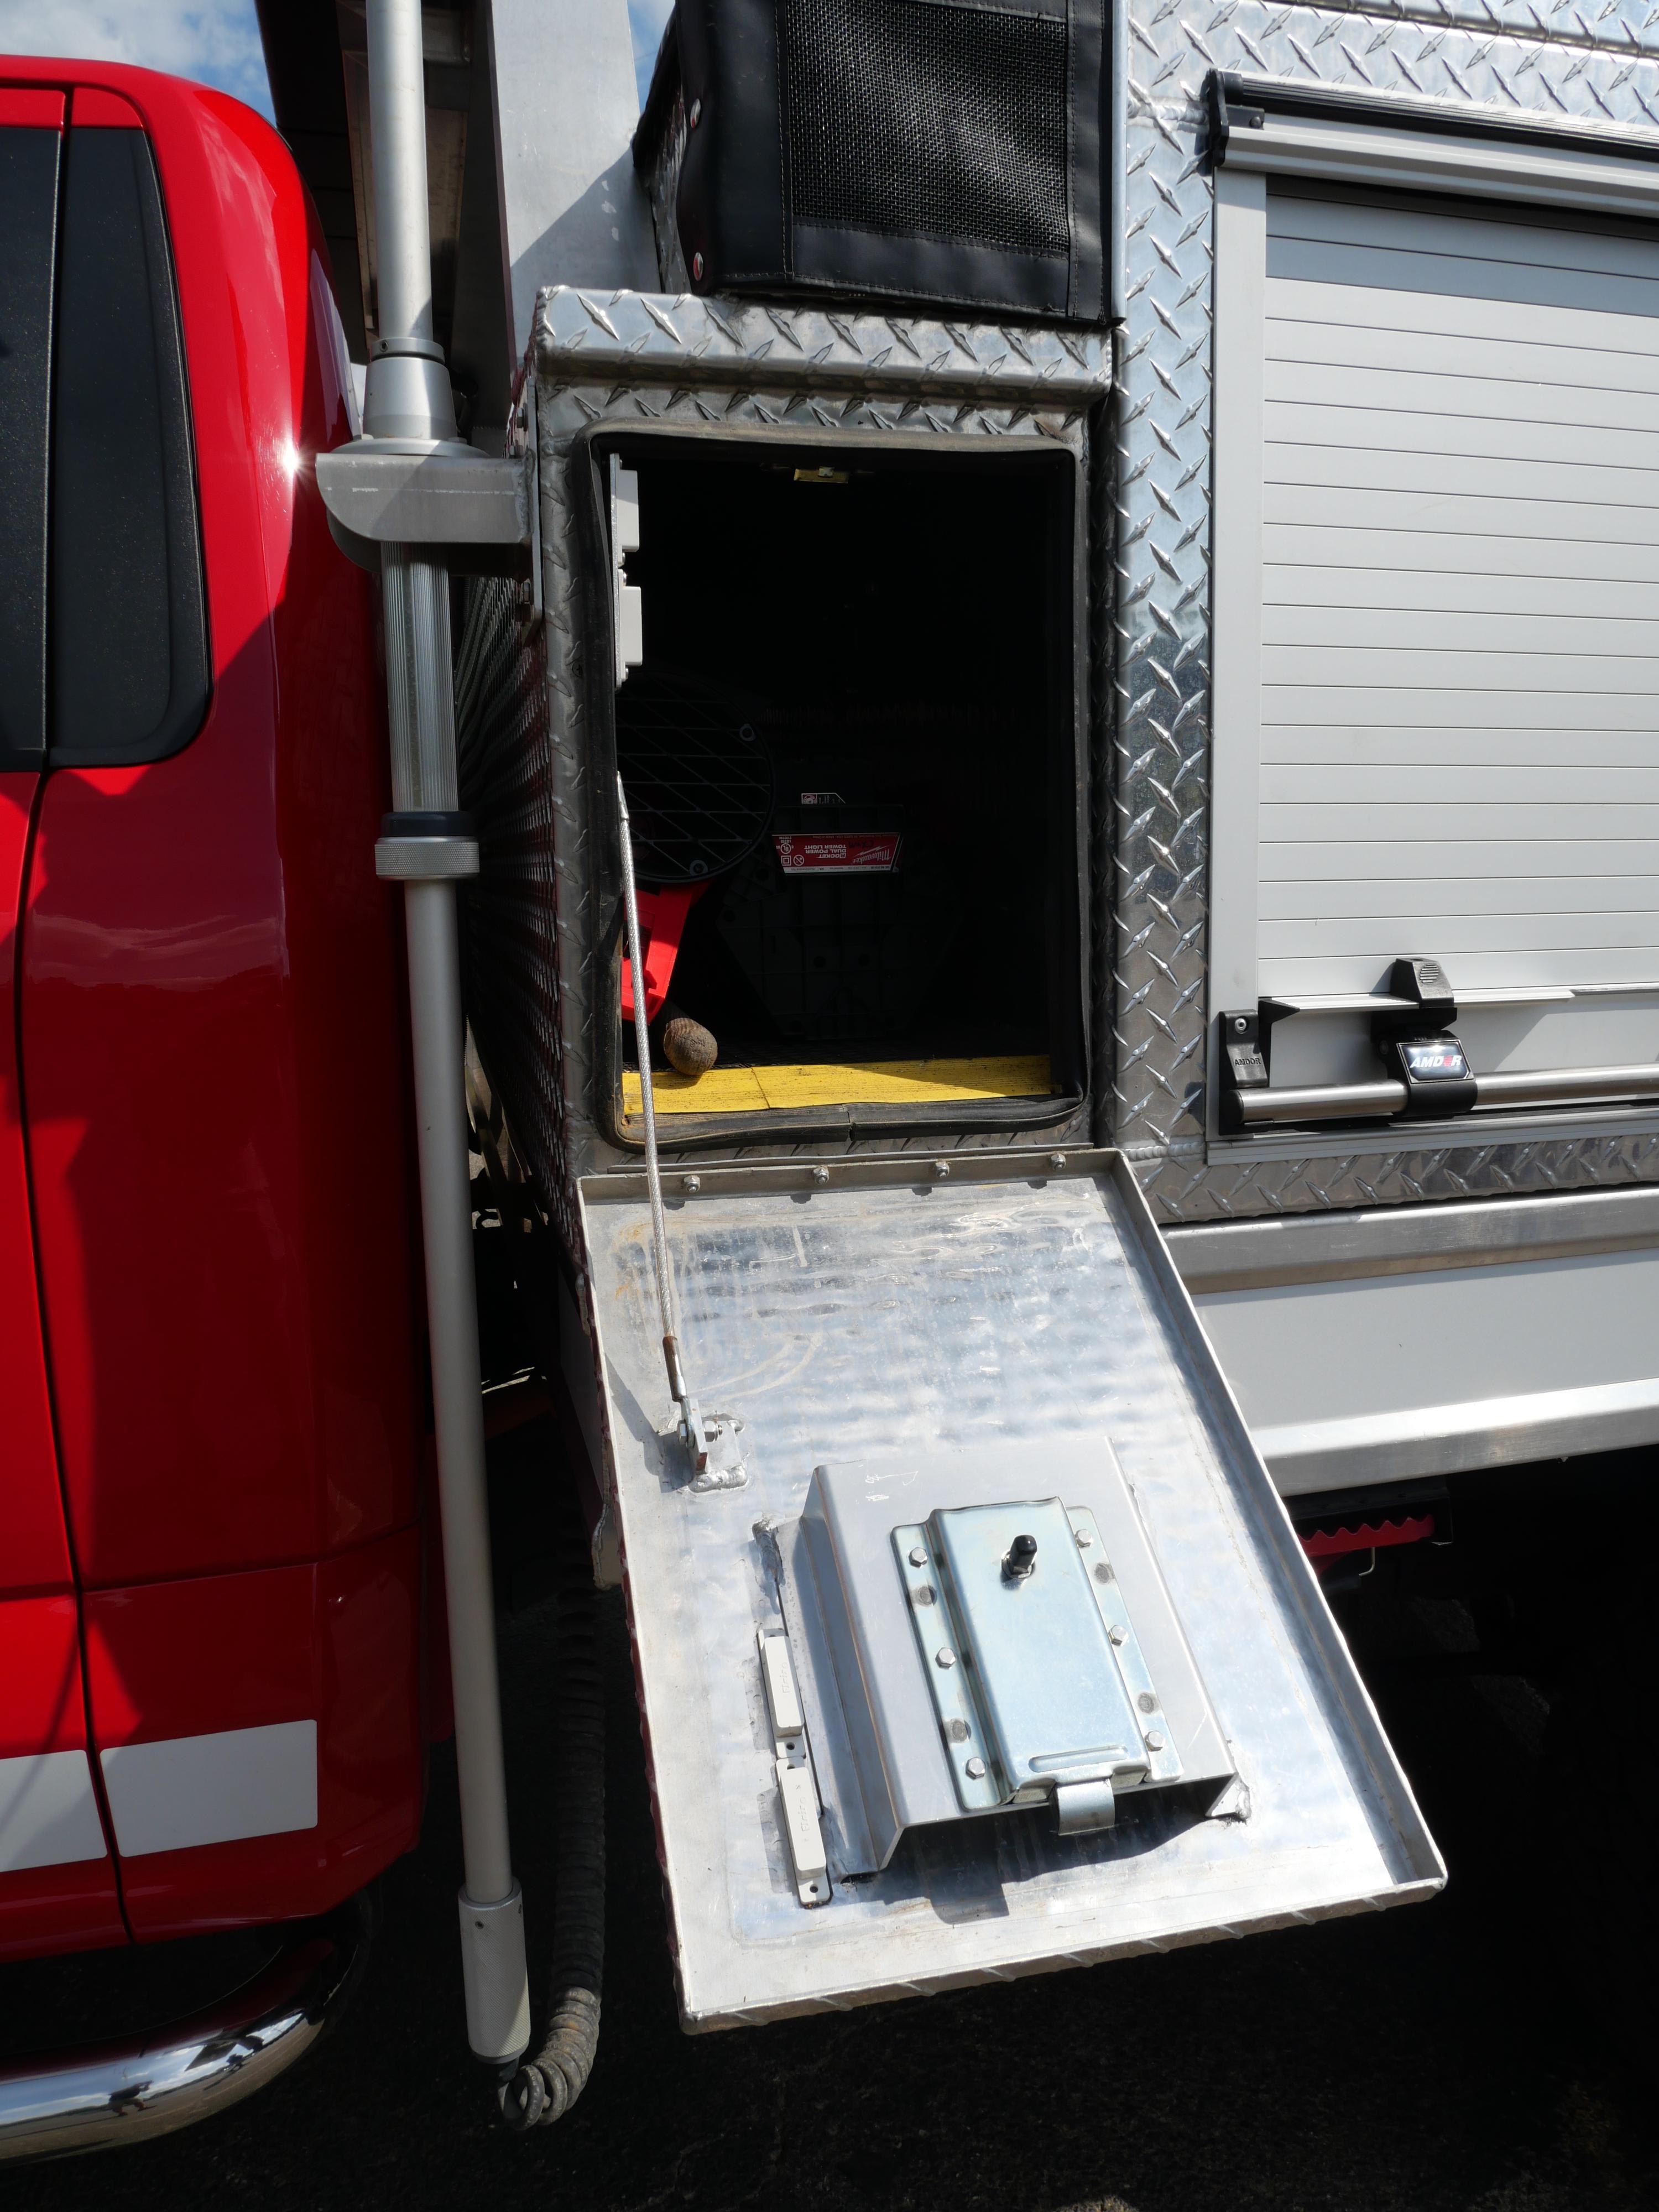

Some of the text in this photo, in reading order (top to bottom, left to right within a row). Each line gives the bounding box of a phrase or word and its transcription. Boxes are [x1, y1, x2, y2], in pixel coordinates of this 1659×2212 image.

[852, 849, 891, 864] Milwaukee
[1234, 1057, 1261, 1067] AMDOR
[1410, 1055, 1462, 1068] AMDOR
